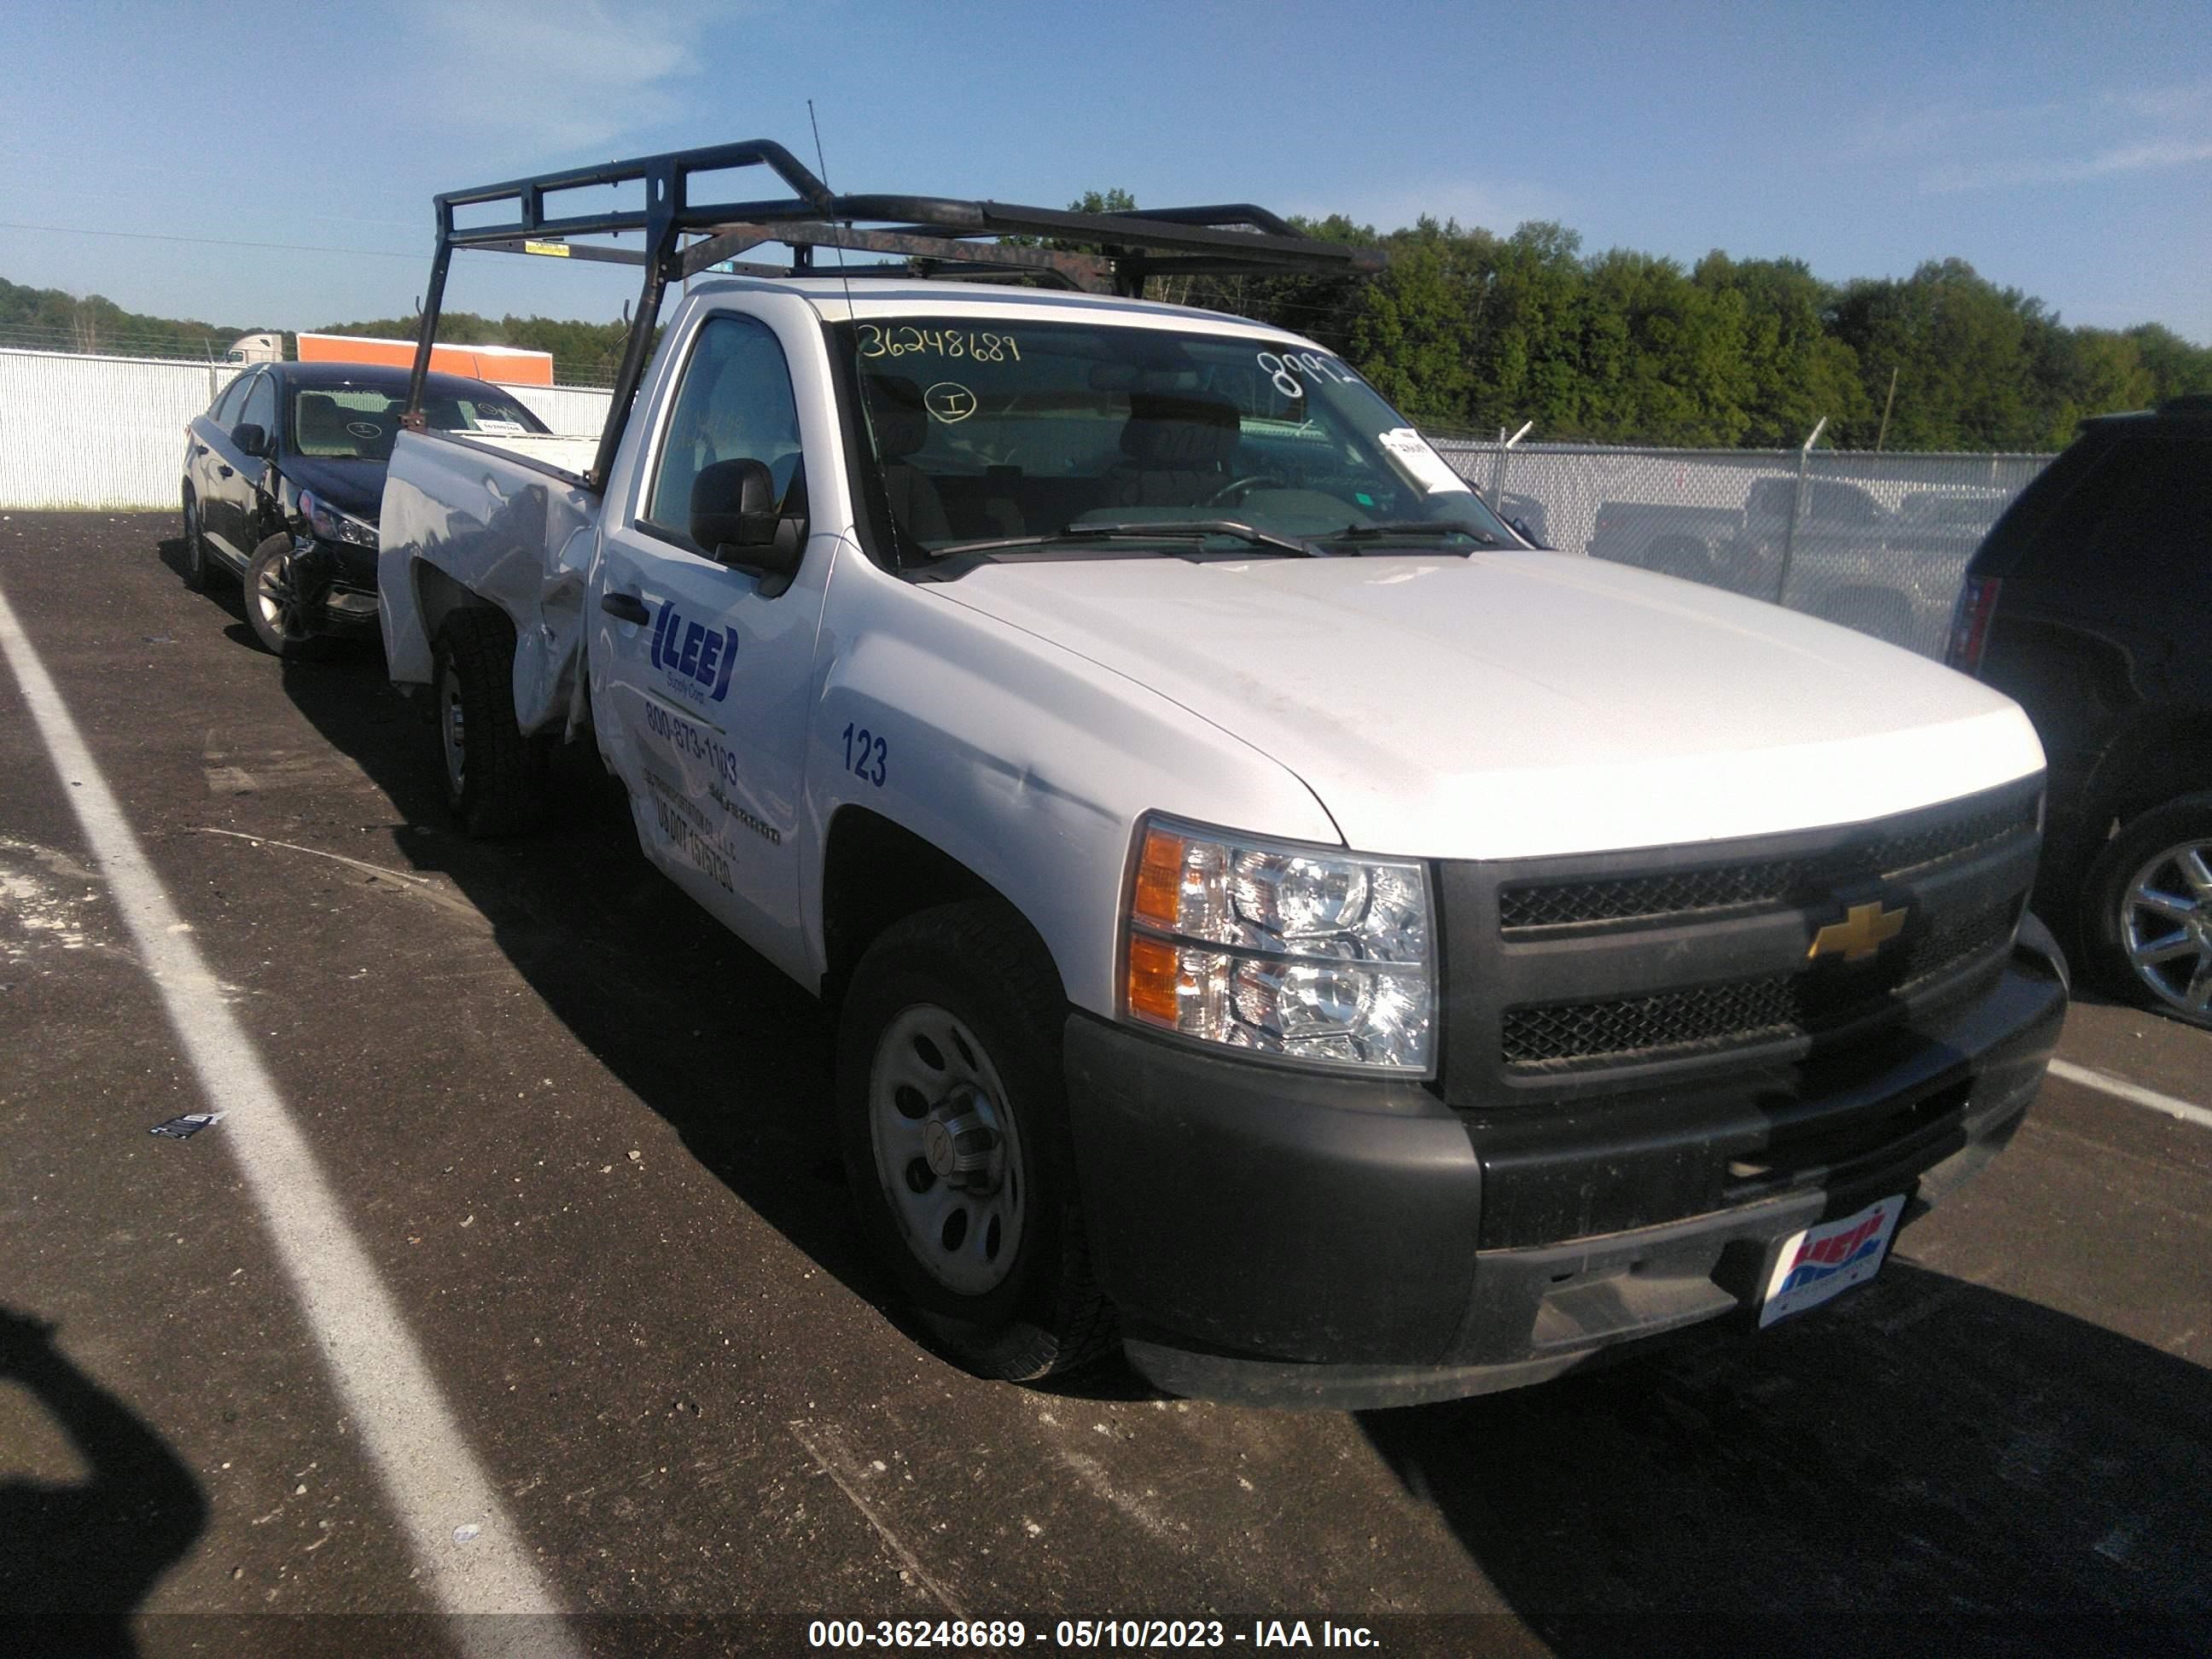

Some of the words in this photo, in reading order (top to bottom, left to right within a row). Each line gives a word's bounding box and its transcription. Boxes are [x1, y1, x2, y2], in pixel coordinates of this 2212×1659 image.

[858, 324, 1021, 362] 36248689
[646, 701, 737, 786] 800-873-1103
[842, 721, 888, 787] 123
[656, 795, 669, 834] US
[670, 809, 687, 853] DOT
